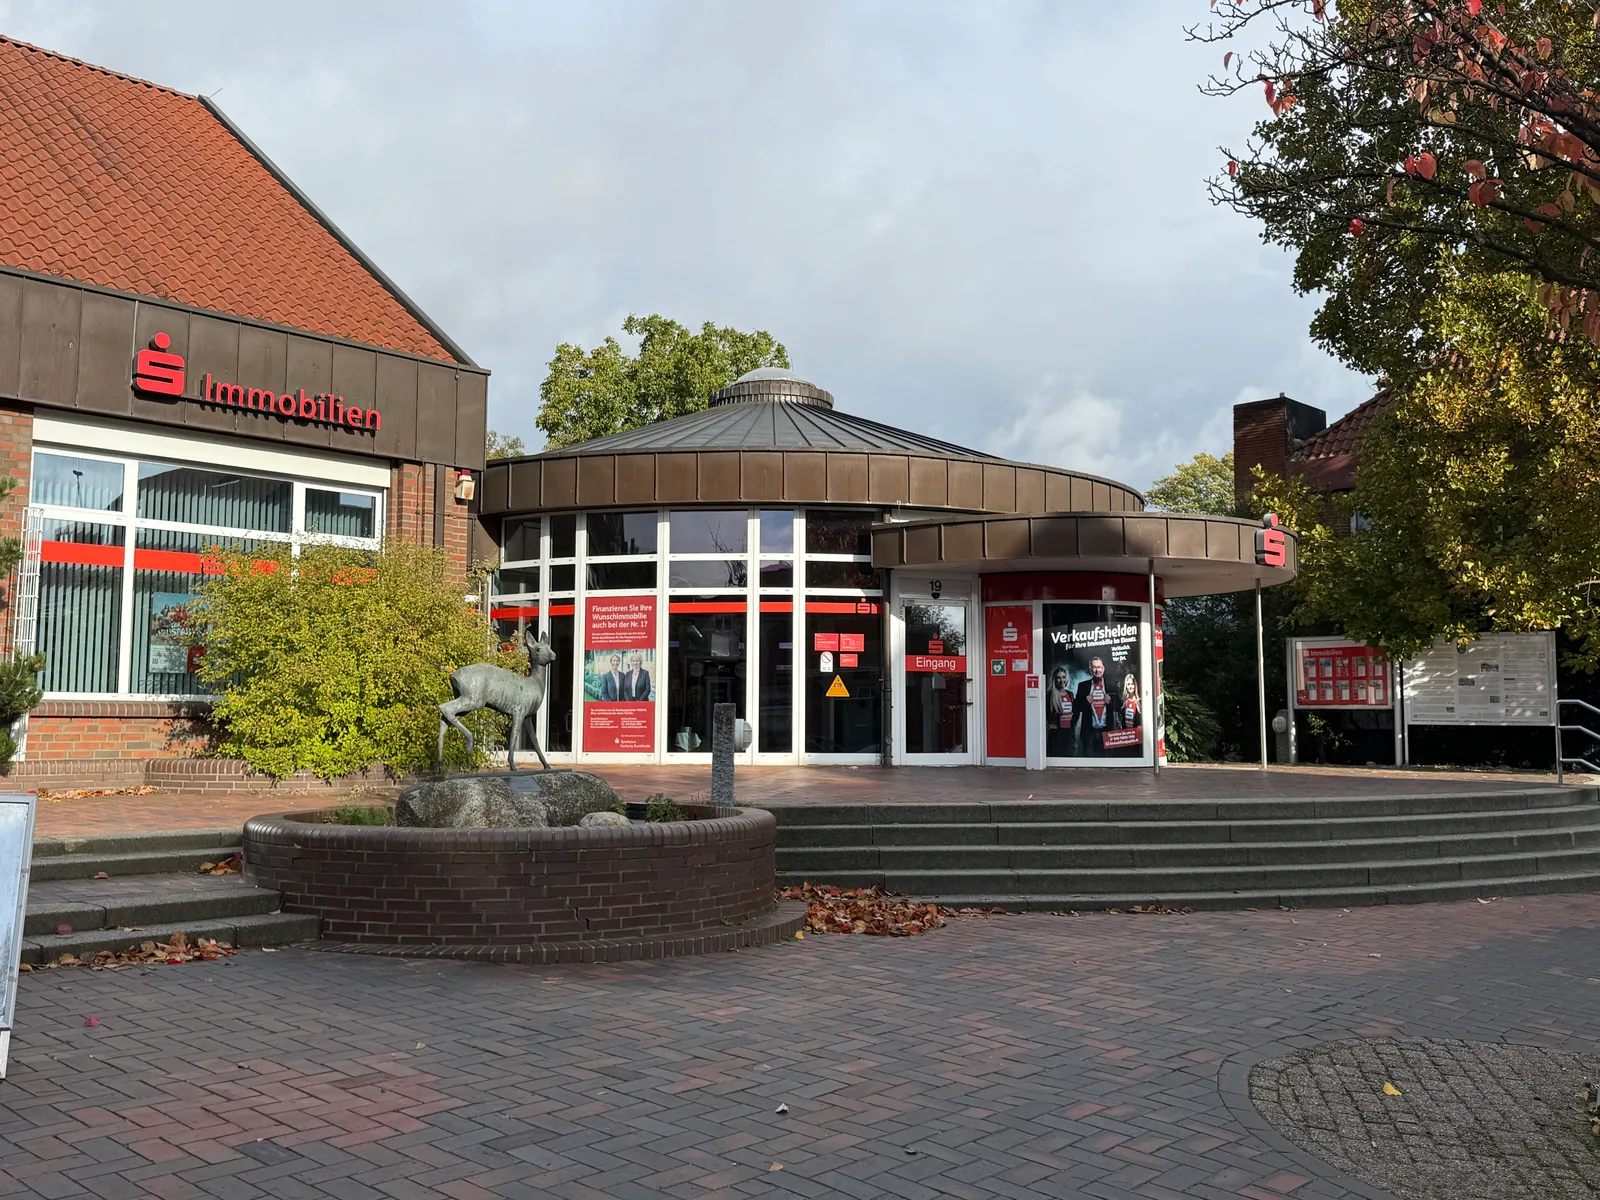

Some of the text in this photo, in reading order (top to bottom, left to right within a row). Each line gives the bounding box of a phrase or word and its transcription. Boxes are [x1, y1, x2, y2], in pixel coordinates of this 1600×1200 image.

[202, 373, 382, 431] Immobilien
[929, 580, 942, 592] 19
[592, 604, 628, 612] Finanzieren
[592, 612, 647, 620] Wunschimmobilie
[592, 620, 648, 629] auch bei der Nr. 1?
[1051, 623, 1138, 644] Verkaufshelden
[1075, 641, 1087, 649] Ihre
[1087, 639, 1113, 647] Immobilie
[916, 657, 956, 670] Eingang
